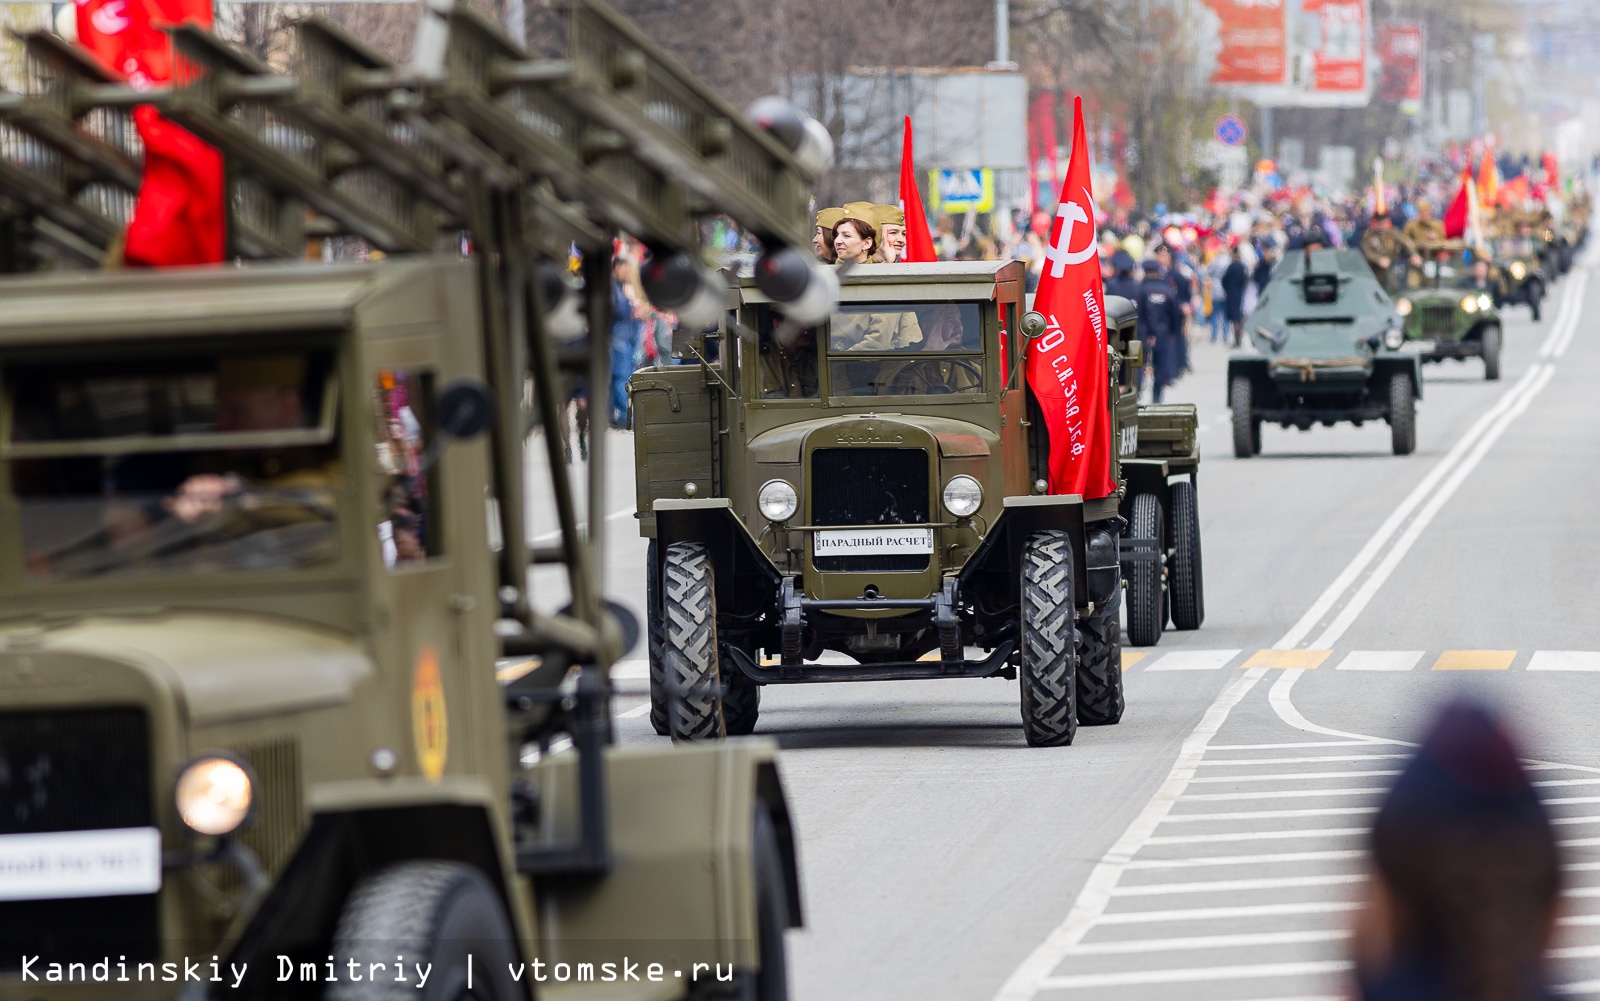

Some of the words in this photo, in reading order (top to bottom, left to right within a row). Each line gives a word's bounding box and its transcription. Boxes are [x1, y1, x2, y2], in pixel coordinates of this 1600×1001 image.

[1036, 314, 1065, 353] 79
[821, 536, 883, 548] ПАРАДНЫЙ
[886, 537, 927, 546] РАСЧЕТ
